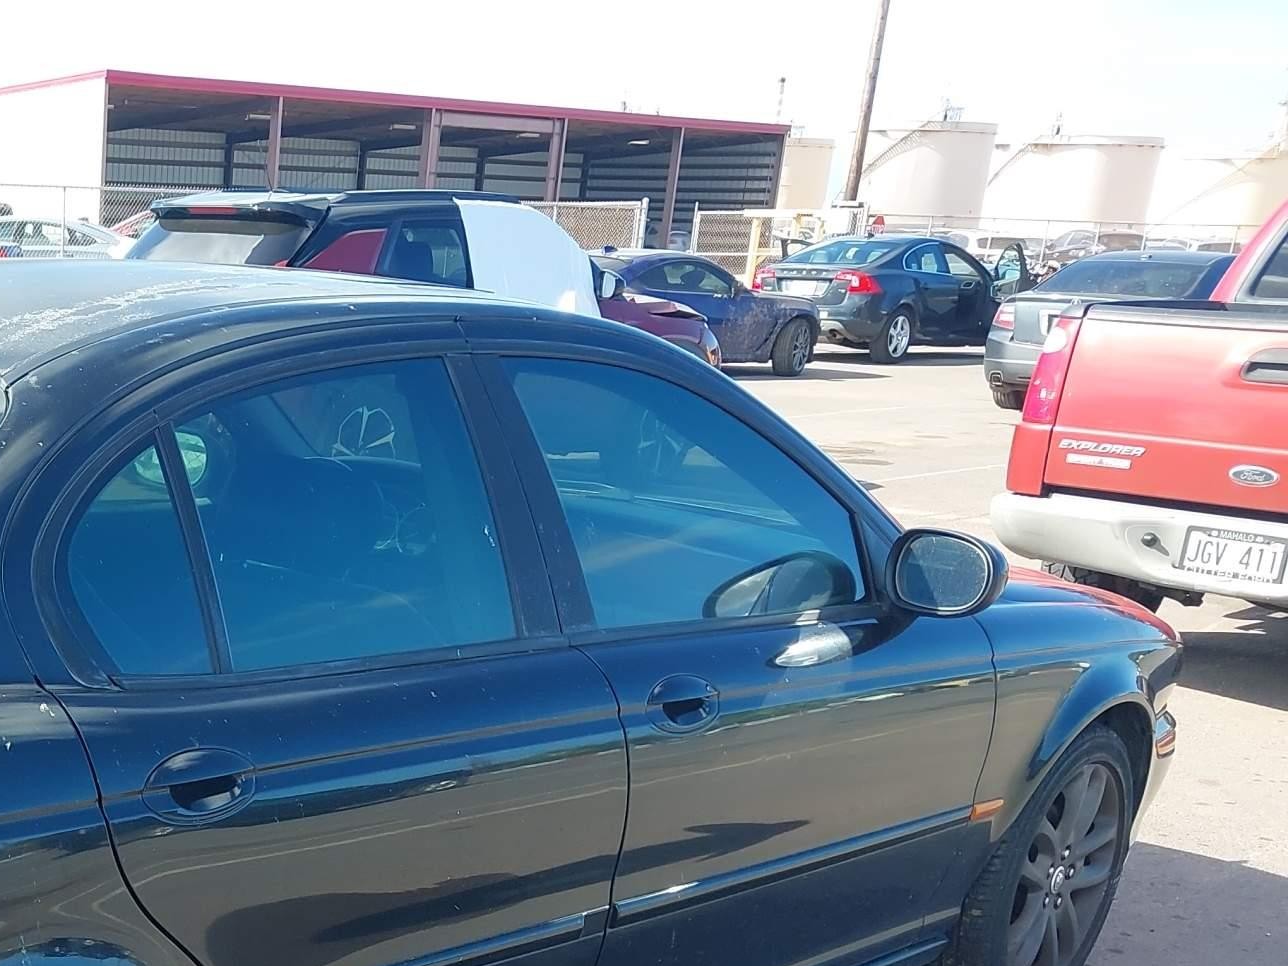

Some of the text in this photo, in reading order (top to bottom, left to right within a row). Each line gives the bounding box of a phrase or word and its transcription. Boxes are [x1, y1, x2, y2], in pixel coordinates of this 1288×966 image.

[1058, 438, 1147, 457] EXPLORER
[1219, 529, 1255, 543] MAHALO
[1187, 539, 1228, 566] JGV
[1239, 546, 1278, 575] 411
